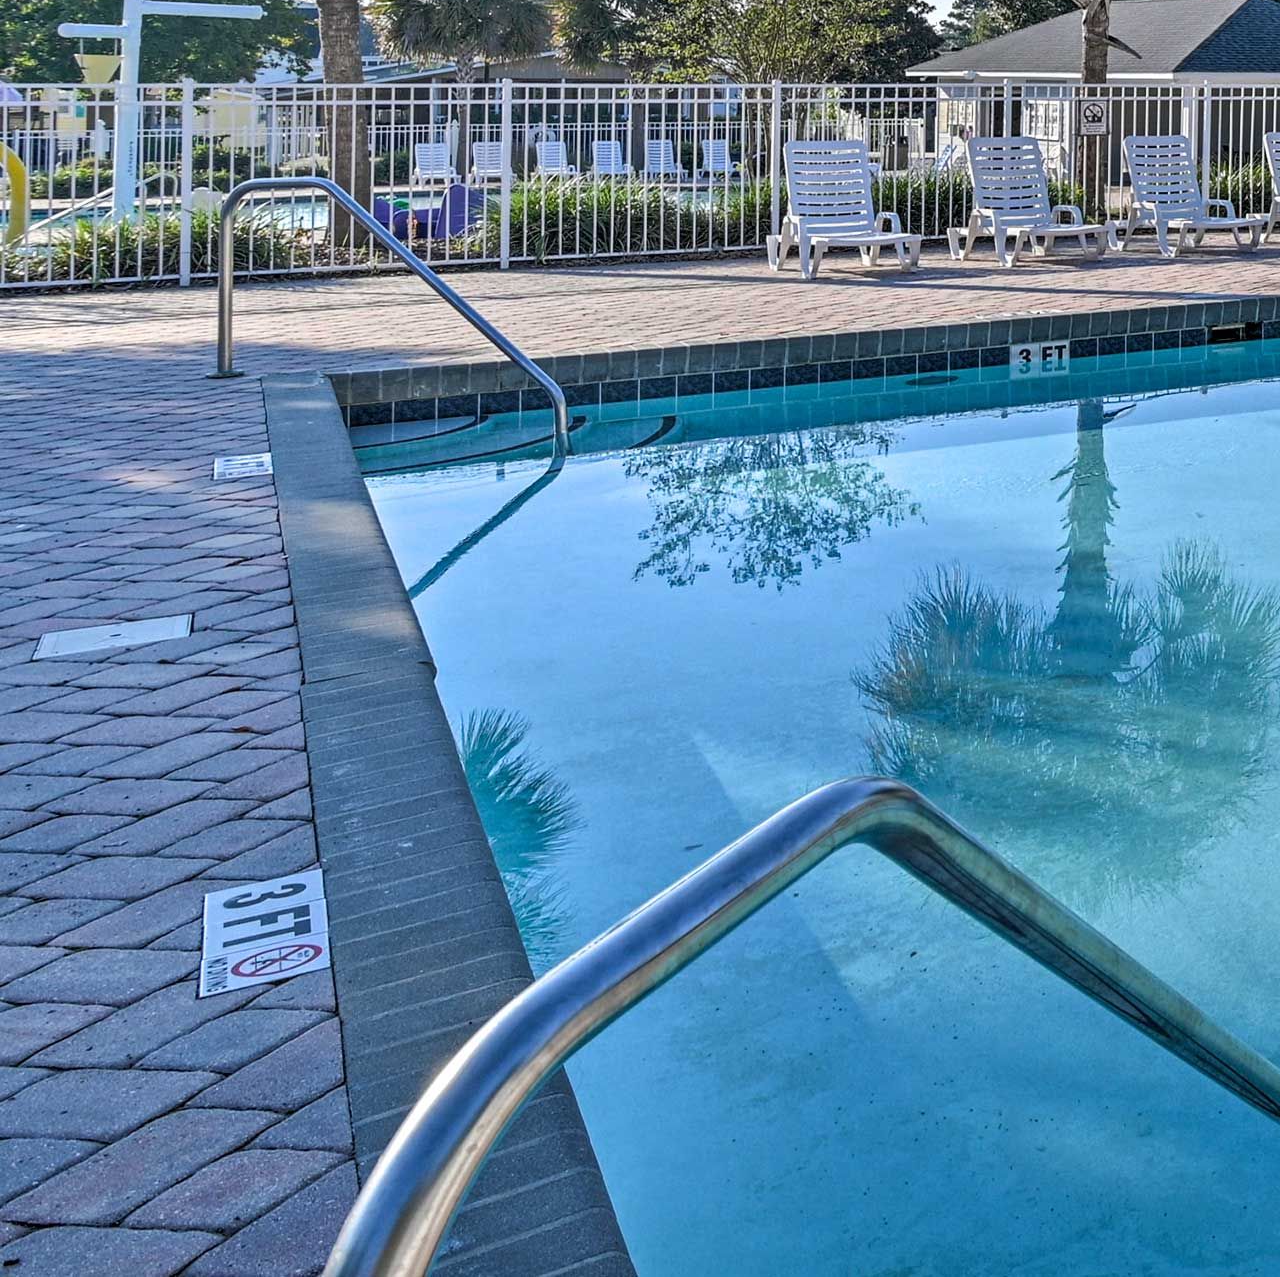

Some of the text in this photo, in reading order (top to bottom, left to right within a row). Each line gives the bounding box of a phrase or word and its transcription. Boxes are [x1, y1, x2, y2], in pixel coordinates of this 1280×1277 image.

[222, 883, 312, 948] 3 FT
[207, 956, 228, 992] NO DIVING
